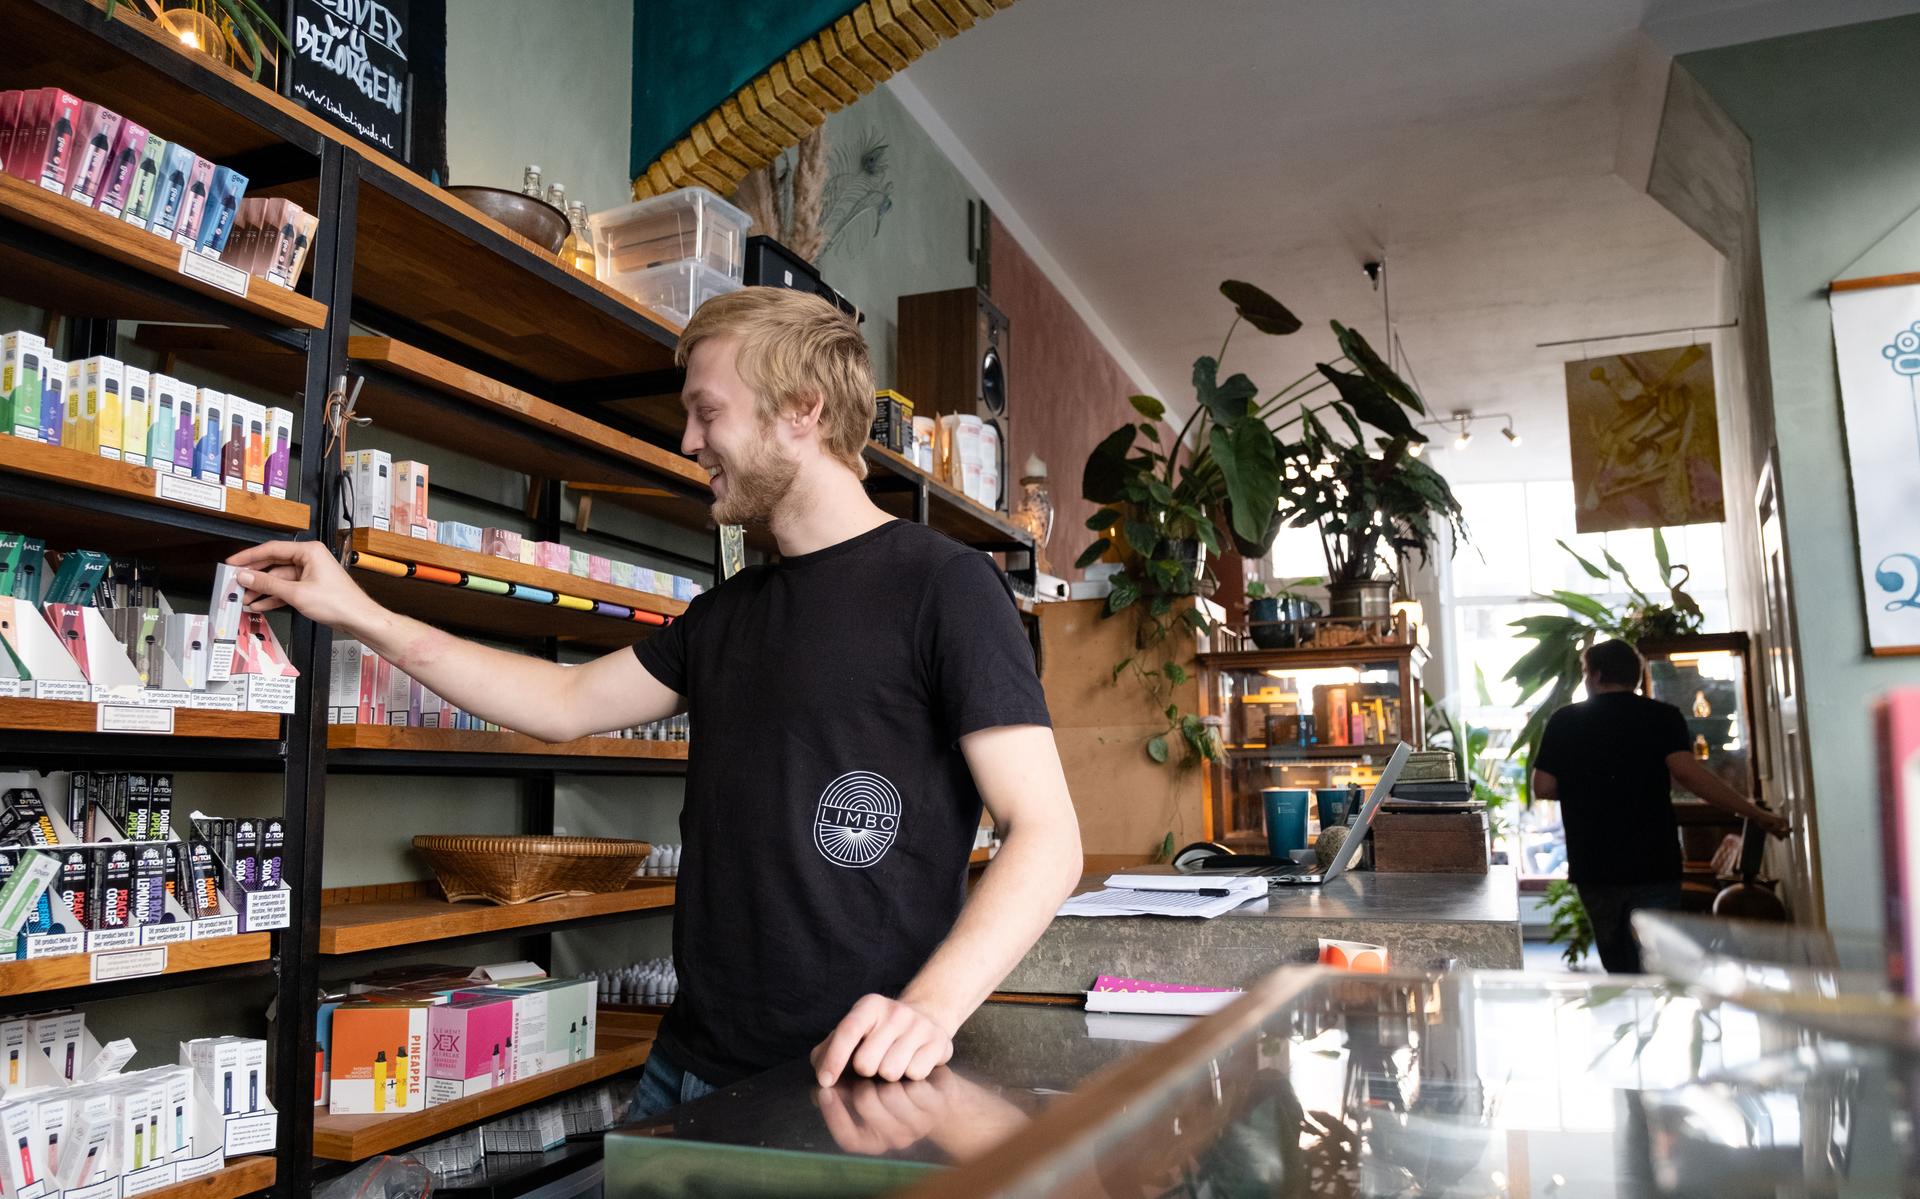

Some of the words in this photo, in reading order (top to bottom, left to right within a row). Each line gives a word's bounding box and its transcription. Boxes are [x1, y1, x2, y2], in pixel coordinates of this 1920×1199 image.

[322, 0, 408, 61] LIVER
[296, 15, 403, 114] BEZORGEN
[101, 111, 117, 122] gee
[231, 174, 245, 184] gee
[23, 541, 42, 552] SALT
[84, 562, 104, 571] SALT
[61, 607, 80, 617] SALT
[143, 612, 160, 622] SALT
[128, 811, 138, 837] APPLE
[136, 808, 148, 840] DOUBLE
[821, 808, 895, 830] LIMBO
[236, 859, 246, 882] SODA
[262, 859, 273, 881] SODA
[117, 889, 128, 918] PEACH
[136, 878, 150, 922] LEMONADE
[195, 878, 209, 909] COOLER
[204, 877, 218, 907] MANGO
[73, 891, 85, 921] PEACH
[105, 888, 118, 924] COOLER
[409, 1035, 421, 1094] PINEAPPLE
